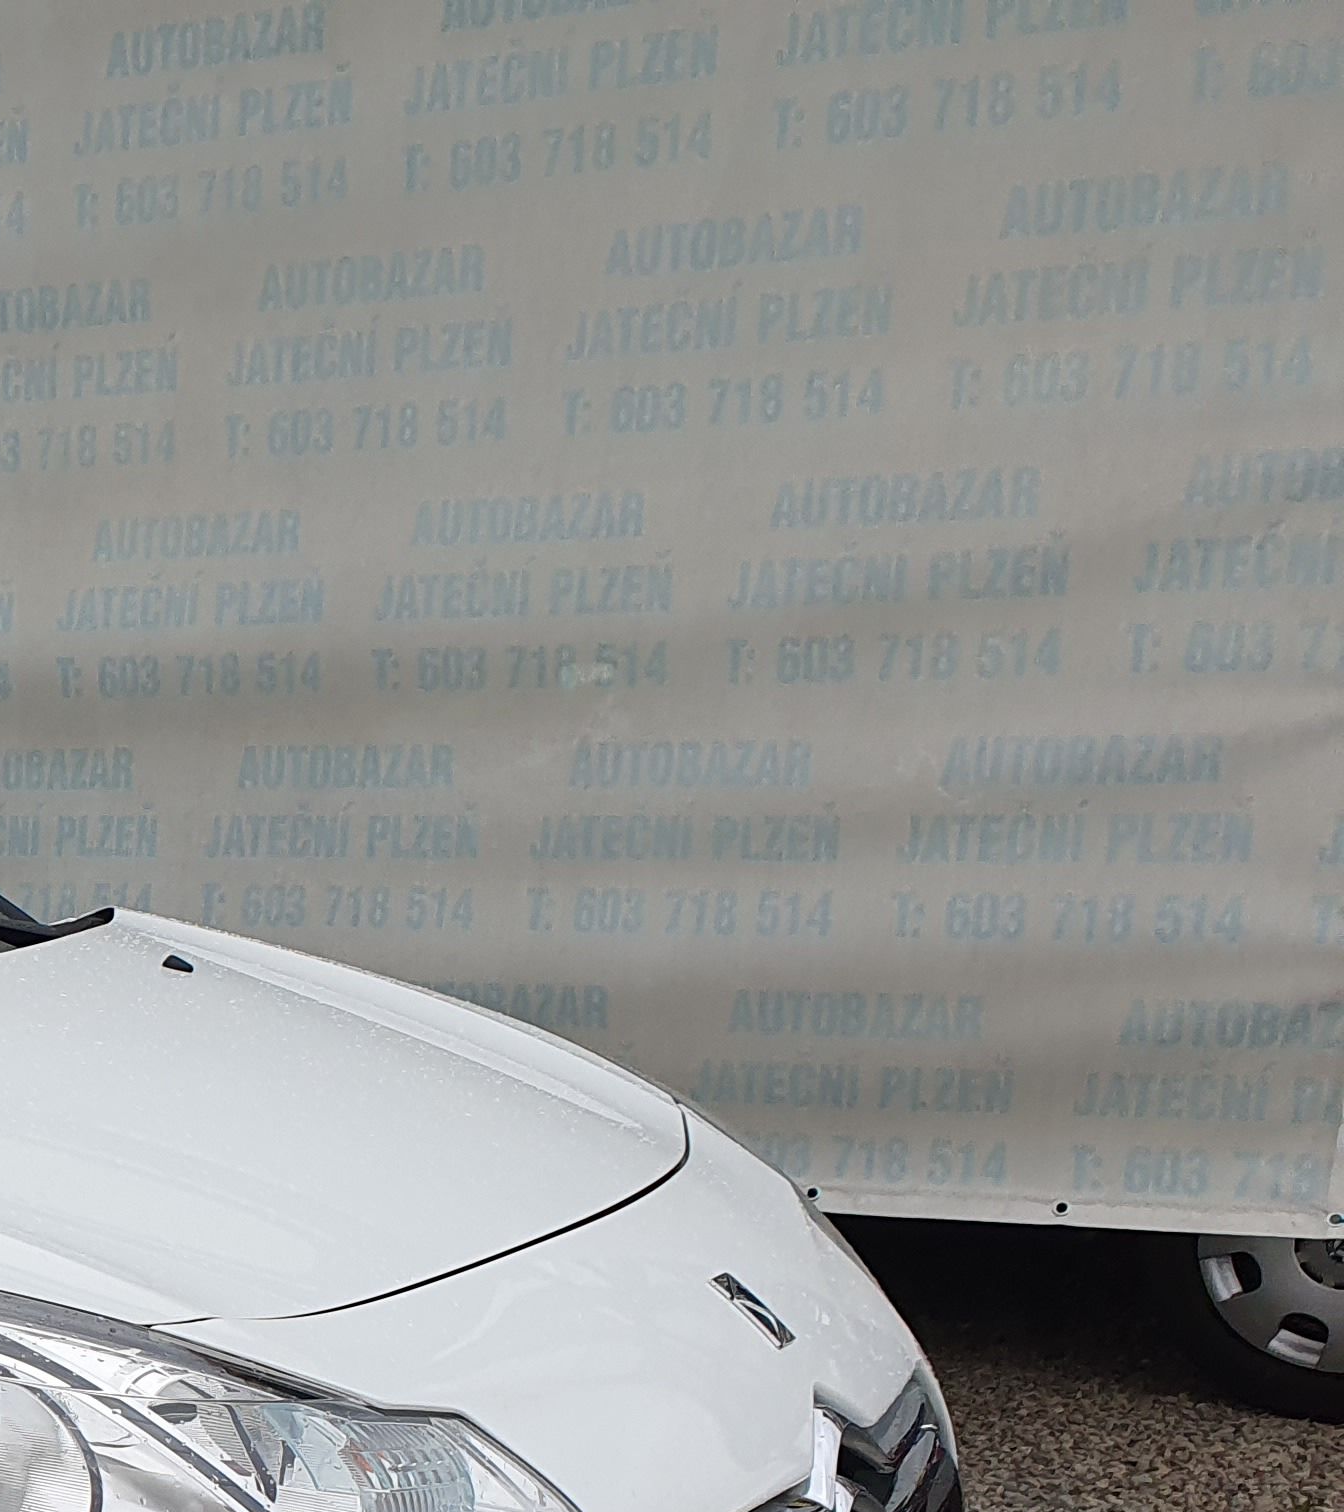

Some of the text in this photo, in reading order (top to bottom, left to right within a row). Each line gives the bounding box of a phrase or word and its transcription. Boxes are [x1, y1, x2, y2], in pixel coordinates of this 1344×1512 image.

[105, 3, 328, 82] AUTOBAZAR
[772, 62, 1125, 154] T: 603 718 514
[402, 110, 714, 197] T: 603 718 514
[74, 158, 350, 234] T: 603 718 514
[998, 161, 1292, 240] AUTOBAZAR
[604, 203, 866, 279] AUTOBAZAR
[255, 243, 487, 315] AUTOBAZAR
[561, 367, 888, 440] T: 603 718 514
[949, 334, 1315, 413] T: 603 718 514
[38, 423, 99, 474] 718
[111, 421, 178, 468] 514
[224, 396, 510, 465] T: 603 718 514
[409, 490, 647, 548] AUTOBAZAR
[768, 465, 1042, 531] AUTOBAZAR
[91, 509, 303, 563] AUTOBAZAR
[54, 652, 325, 704] T: 603 718 514
[370, 639, 673, 697] T: 603 718 514
[724, 626, 1064, 689] T: 603 718 514
[235, 743, 457, 792] AUTOBAZAR
[567, 739, 814, 791] AUTOBAZAR
[938, 735, 1225, 788] AUTOBAZAR
[200, 881, 475, 936] T: 603 718 514
[526, 886, 835, 942] T: 603 718 514
[893, 891, 1250, 952] T: 603 718 514
[727, 988, 985, 1042] AUTOBAZAR
